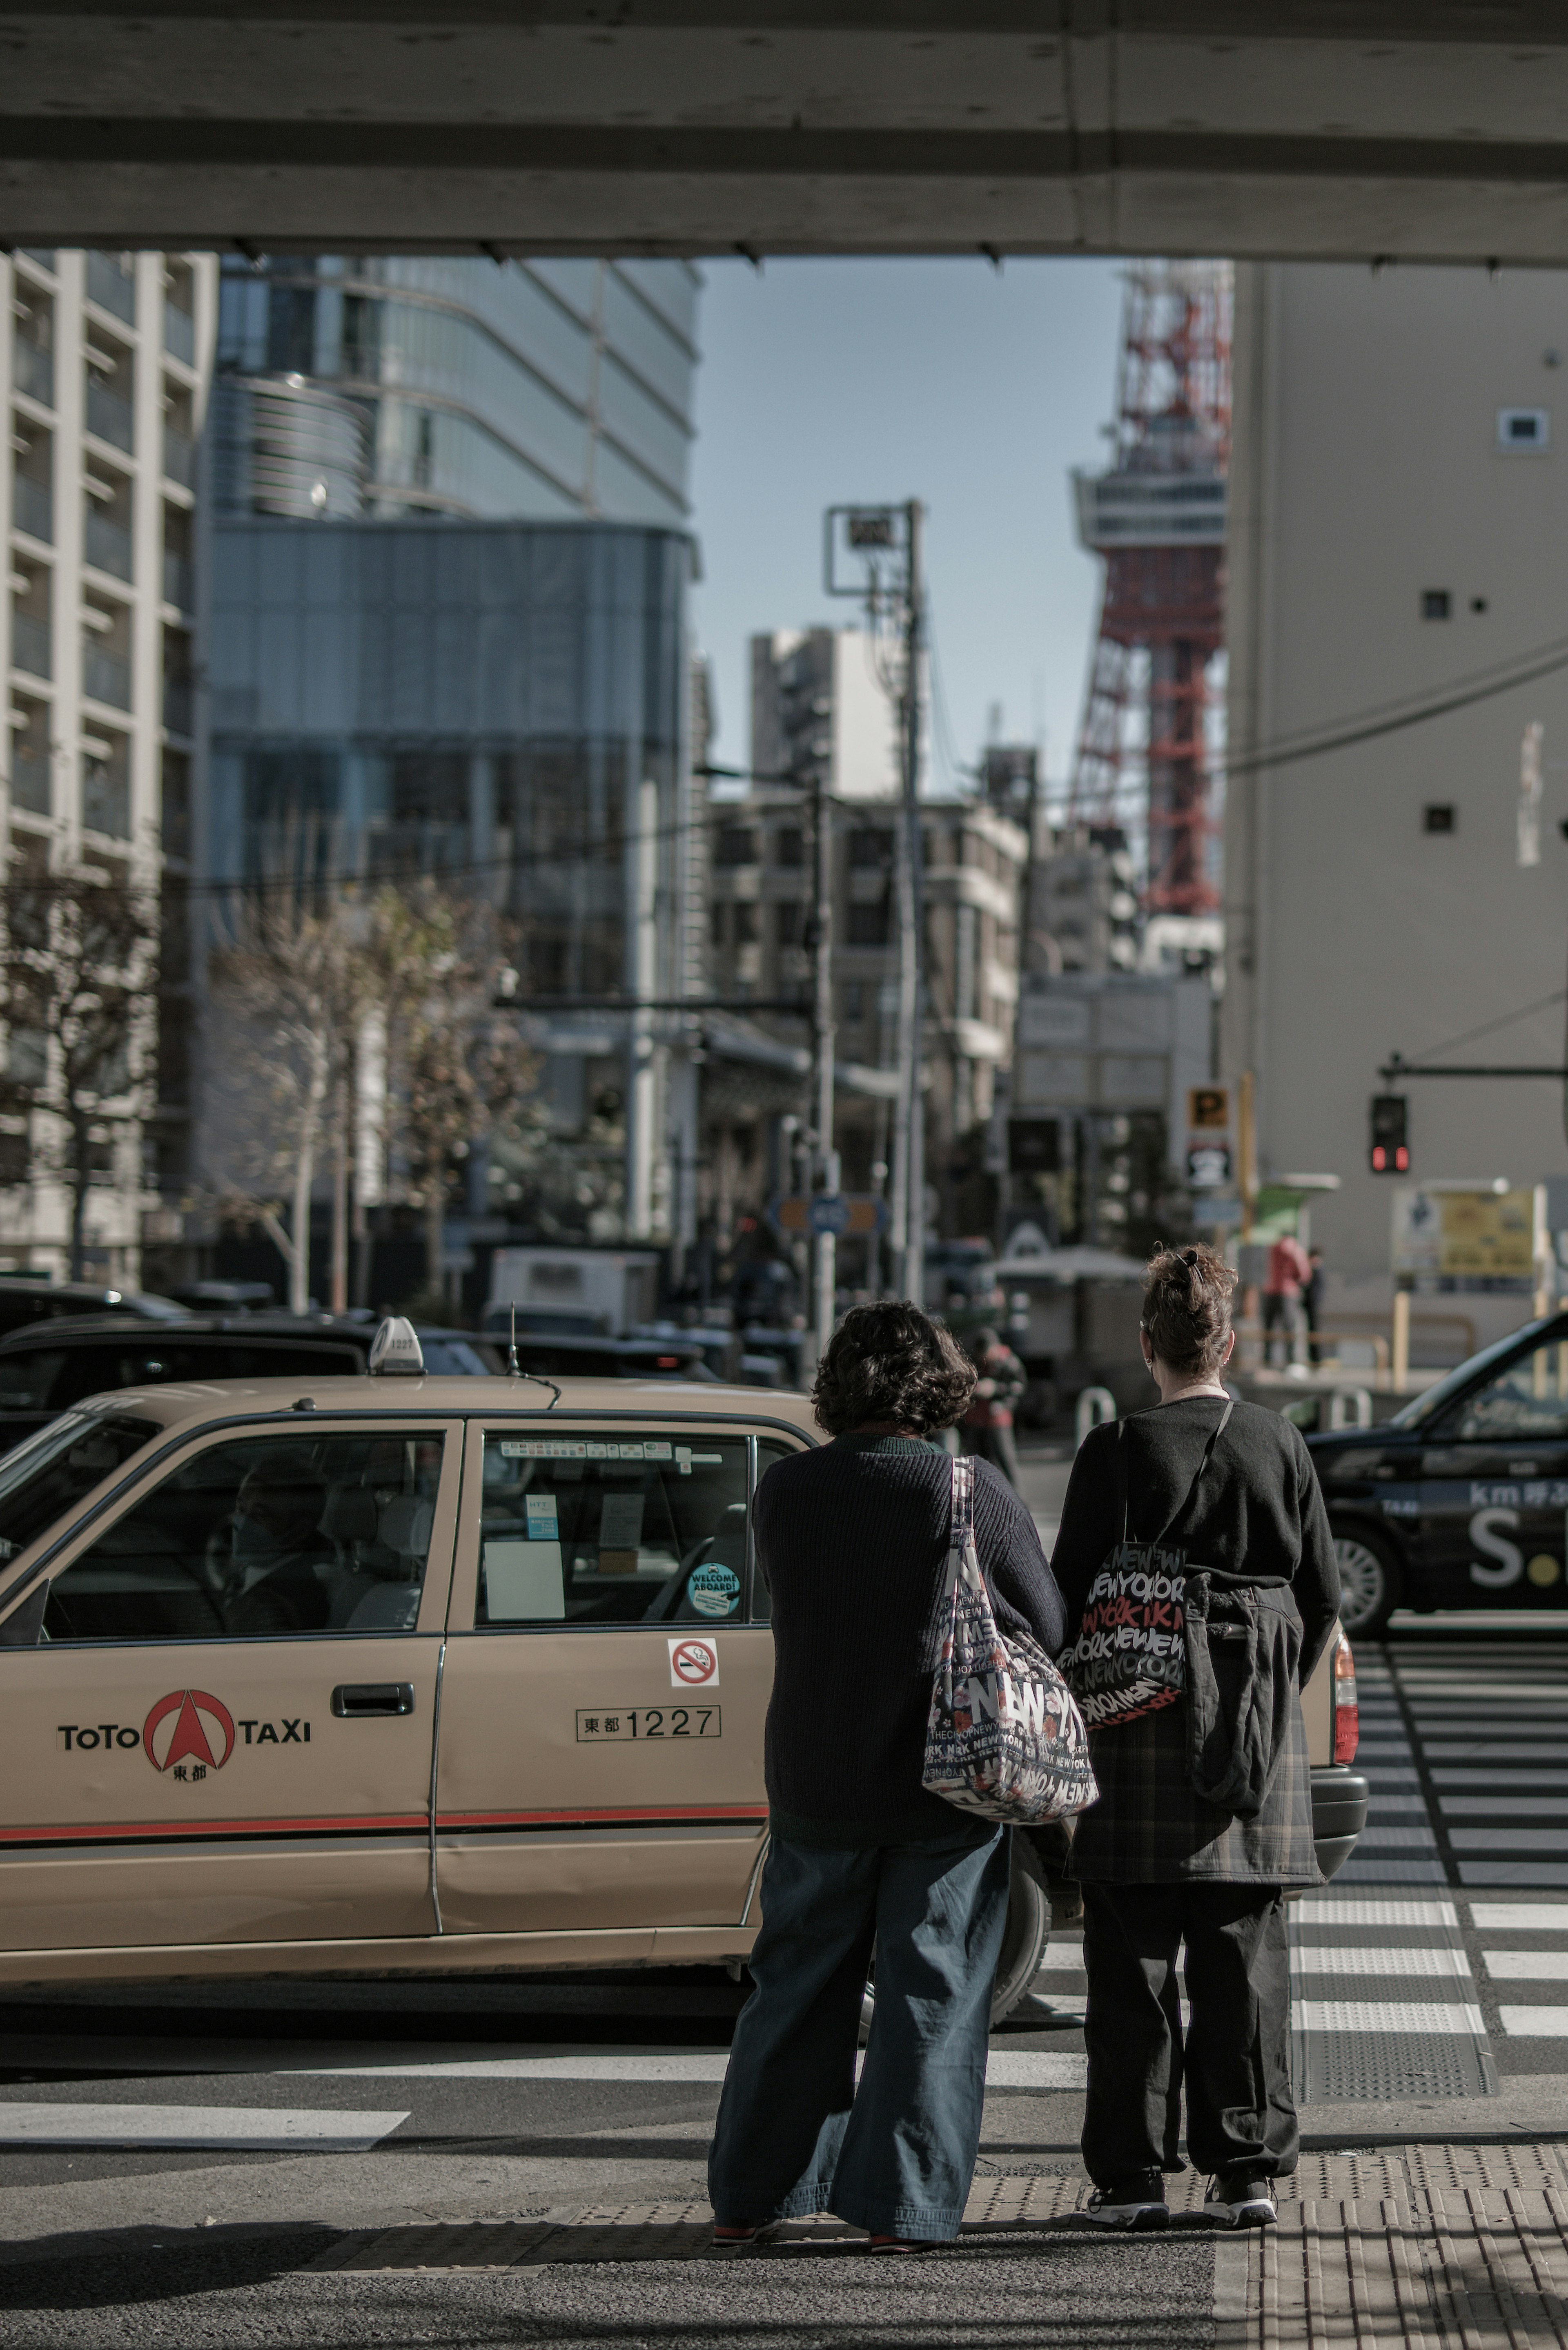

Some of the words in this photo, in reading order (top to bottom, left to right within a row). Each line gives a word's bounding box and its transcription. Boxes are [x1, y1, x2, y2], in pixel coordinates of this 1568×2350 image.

[1195, 1089, 1223, 1124] P
[392, 1339, 413, 1349] 1227
[695, 1582, 735, 1590] ABOARD!
[584, 1717, 619, 1733] 東都
[627, 1709, 713, 1737] 1227
[173, 1765, 207, 1782] 東都
